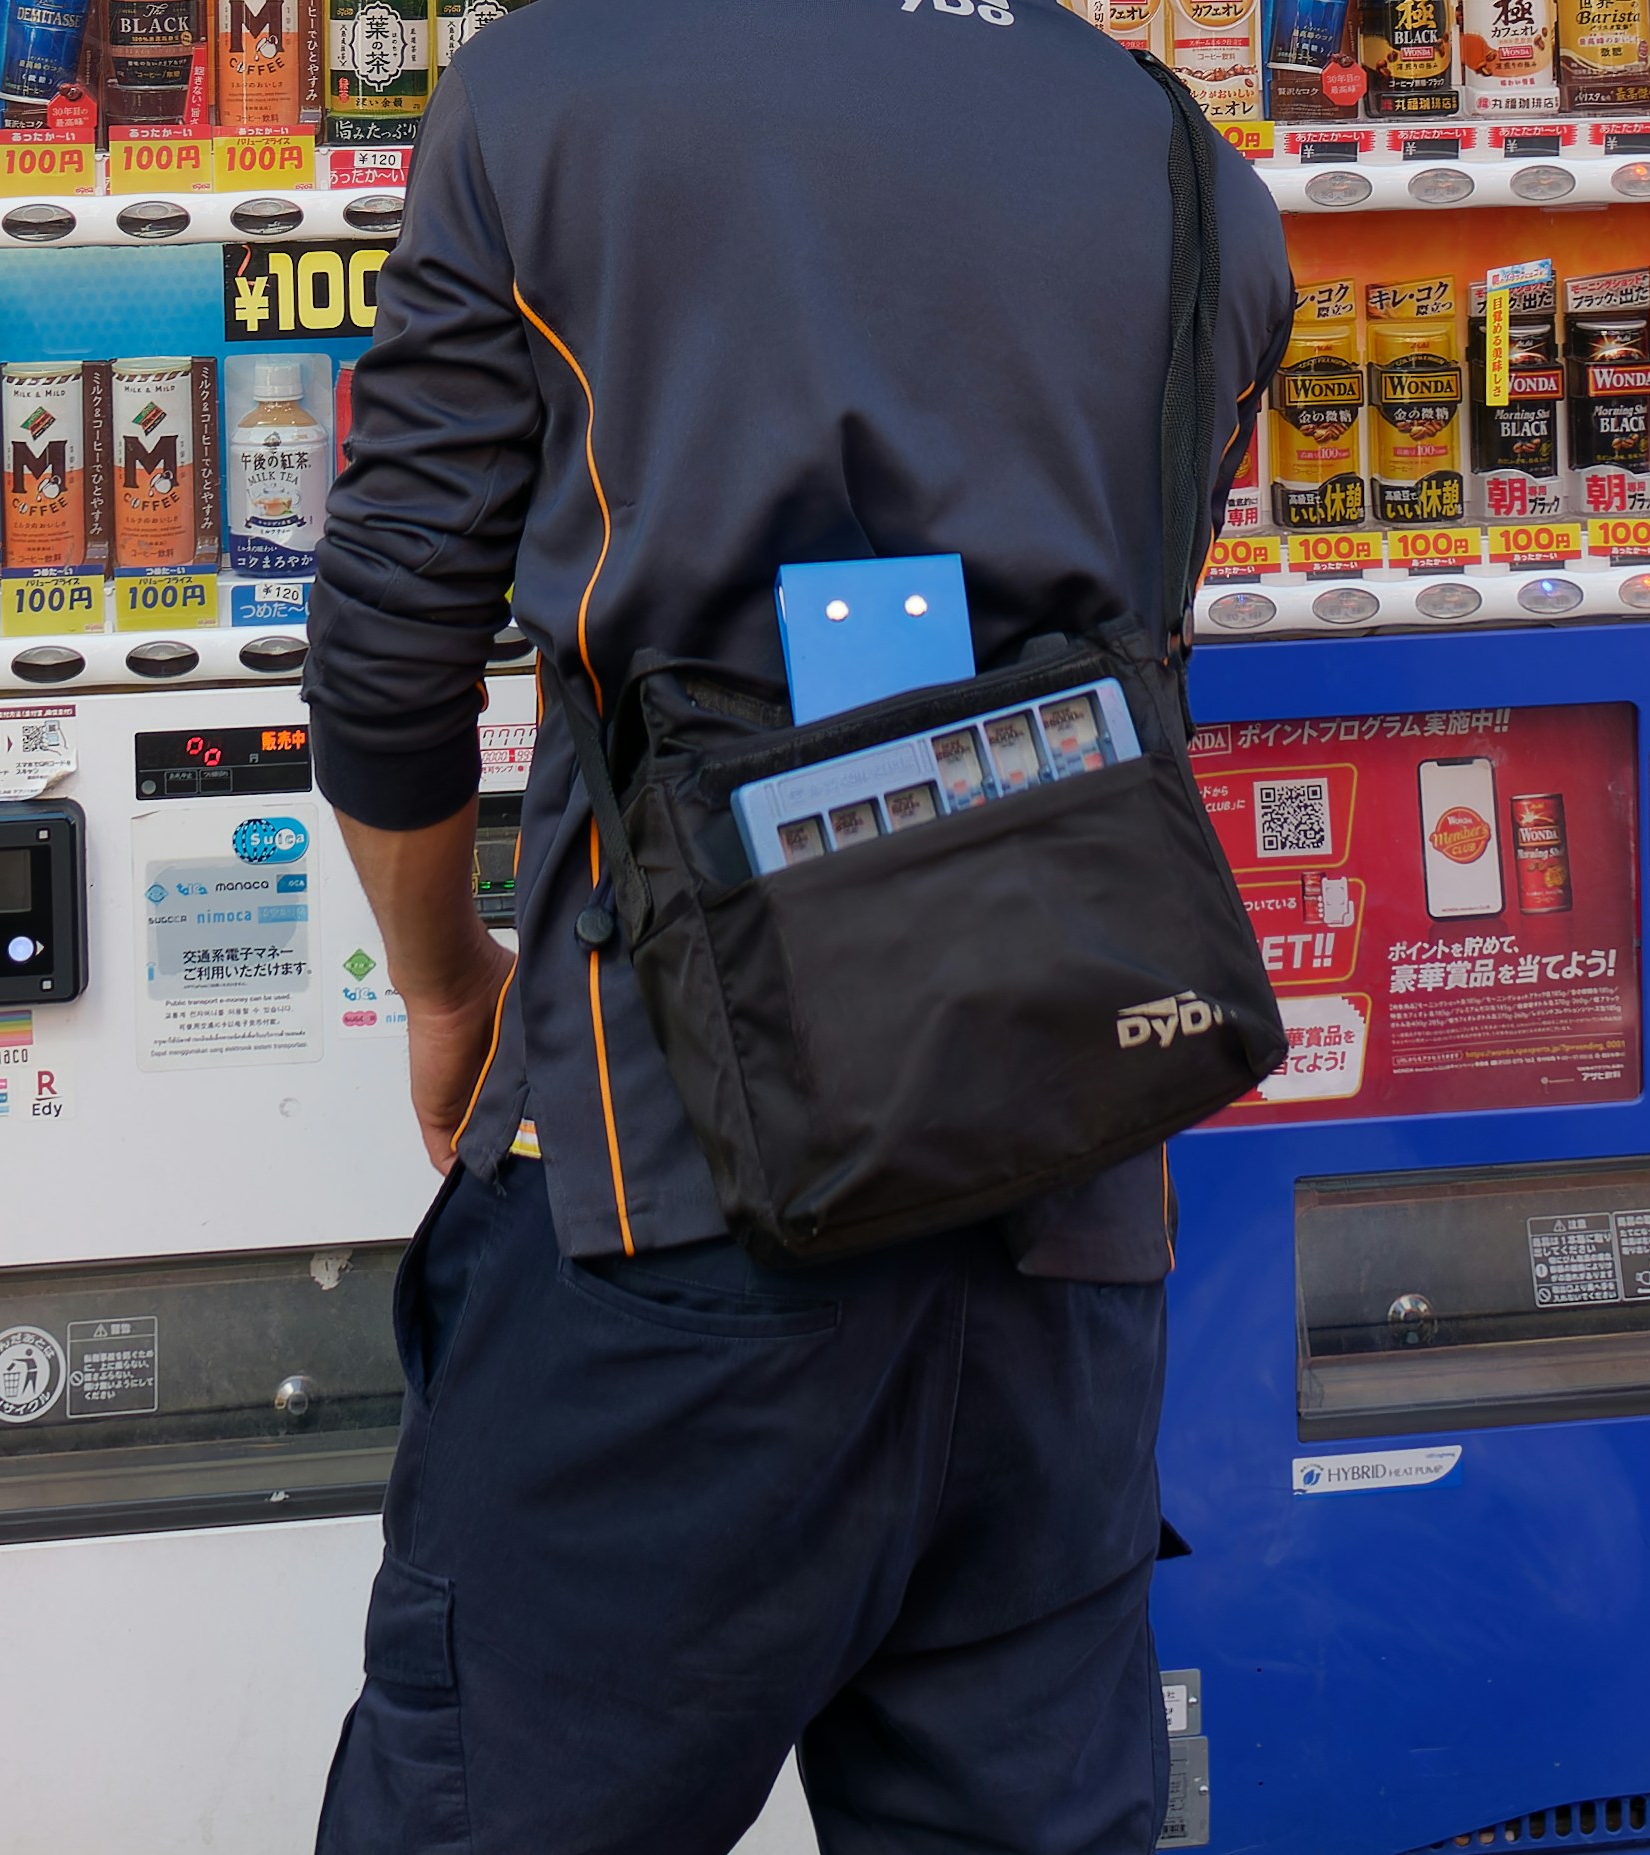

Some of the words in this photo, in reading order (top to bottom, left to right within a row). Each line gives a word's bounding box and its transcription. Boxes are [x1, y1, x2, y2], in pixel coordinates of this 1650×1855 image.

[17, 6, 82, 29] DEMITASSE
[1192, 1, 1245, 18] カフェオレ
[120, 16, 191, 35] BLACK
[363, 15, 391, 76] 葉の茶
[1394, 28, 1438, 44] BLACK
[1491, 295, 1503, 398] 目覚める美味しさ
[1390, 374, 1455, 397] WONDA
[239, 450, 311, 469] 午後の紅茶
[248, 472, 278, 485] MILK
[280, 471, 300, 484] TEA
[236, 554, 314, 570] コクまろやか
[128, 583, 206, 610] 100円
[1237, 709, 1511, 748] ポイントプログラム実施中!!
[261, 730, 306, 751] 販売中
[250, 832, 306, 847] Suica
[215, 879, 270, 892] manaca
[197, 908, 252, 924] nimoca
[183, 946, 294, 964] 交通系電子マネー
[1388, 938, 1520, 961] ポイントを貯めて、
[183, 963, 312, 981] ご利用いただけます。
[1390, 949, 1617, 993] 豪華賞品を当てよう!
[31, 1099, 63, 1118] Edy
